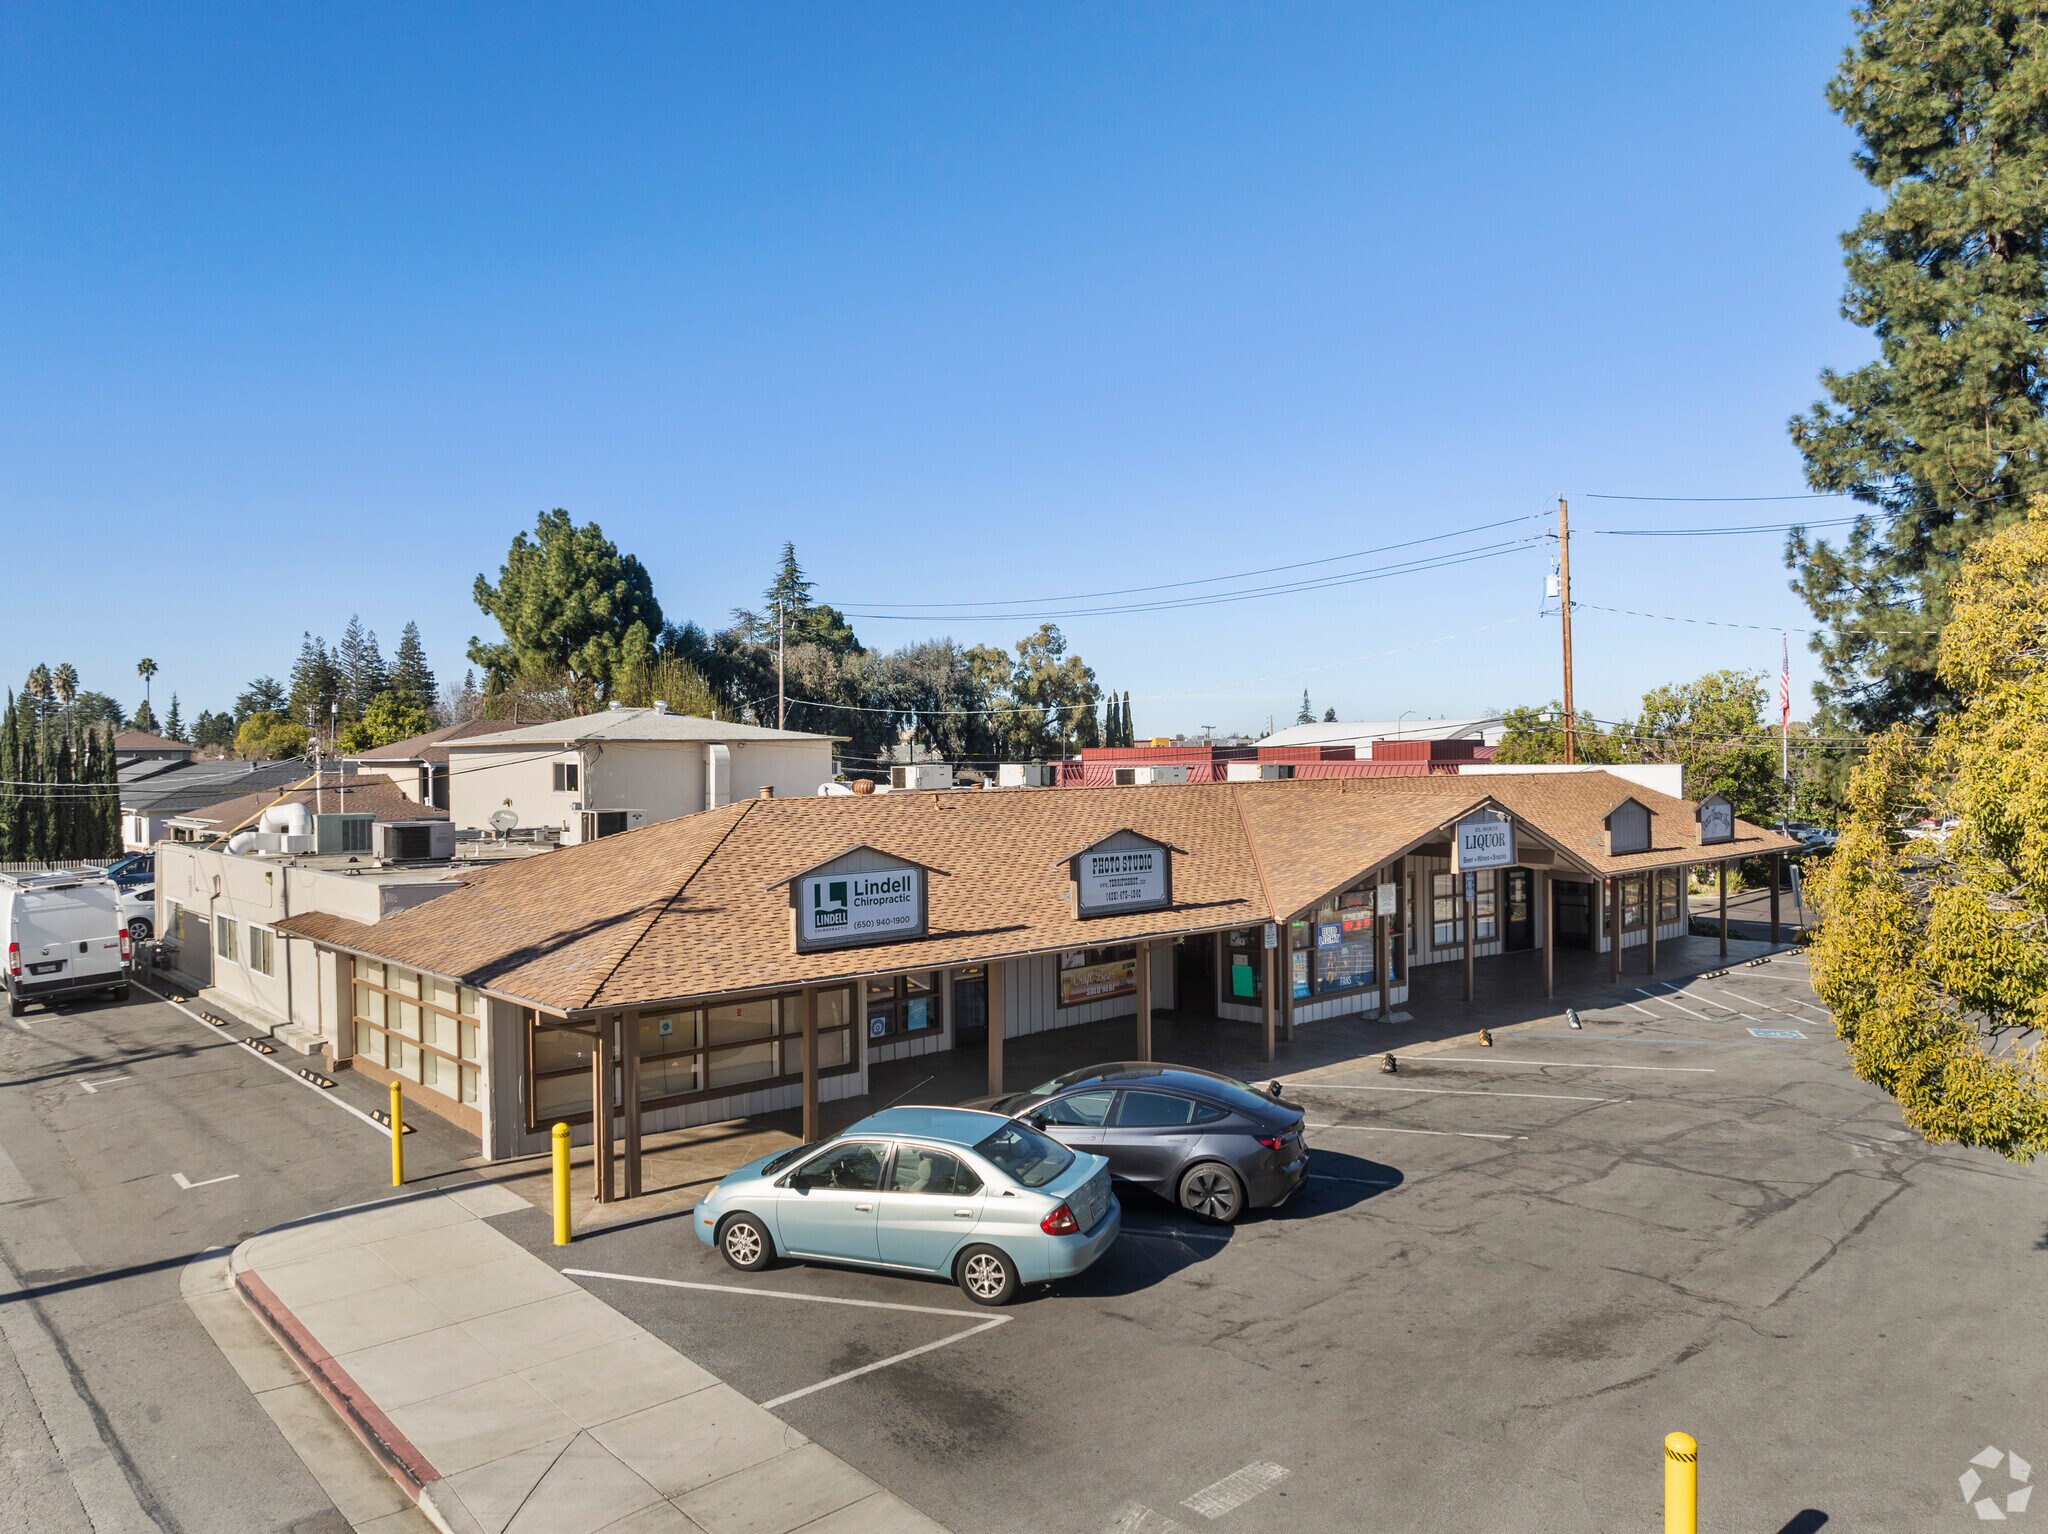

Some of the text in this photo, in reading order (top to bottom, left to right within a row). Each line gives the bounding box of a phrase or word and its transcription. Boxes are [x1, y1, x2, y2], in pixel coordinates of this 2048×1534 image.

[1465, 833, 1505, 851] LIQUOR
[1092, 854, 1152, 875] PHOTO STUDIO
[1463, 856, 1474, 864] Beer
[854, 875, 911, 896] Lindell
[854, 893, 911, 907] Chiropractic
[816, 912, 848, 926] LINDELL
[853, 916, 910, 930] (650) 940-1900
[815, 926, 848, 934] CHIROPRACTIC
[1321, 926, 1338, 937] BUD
[1319, 934, 1340, 945] LIGHT
[1073, 968, 1116, 986] Craft Beer
[1339, 975, 1352, 986] FANS
